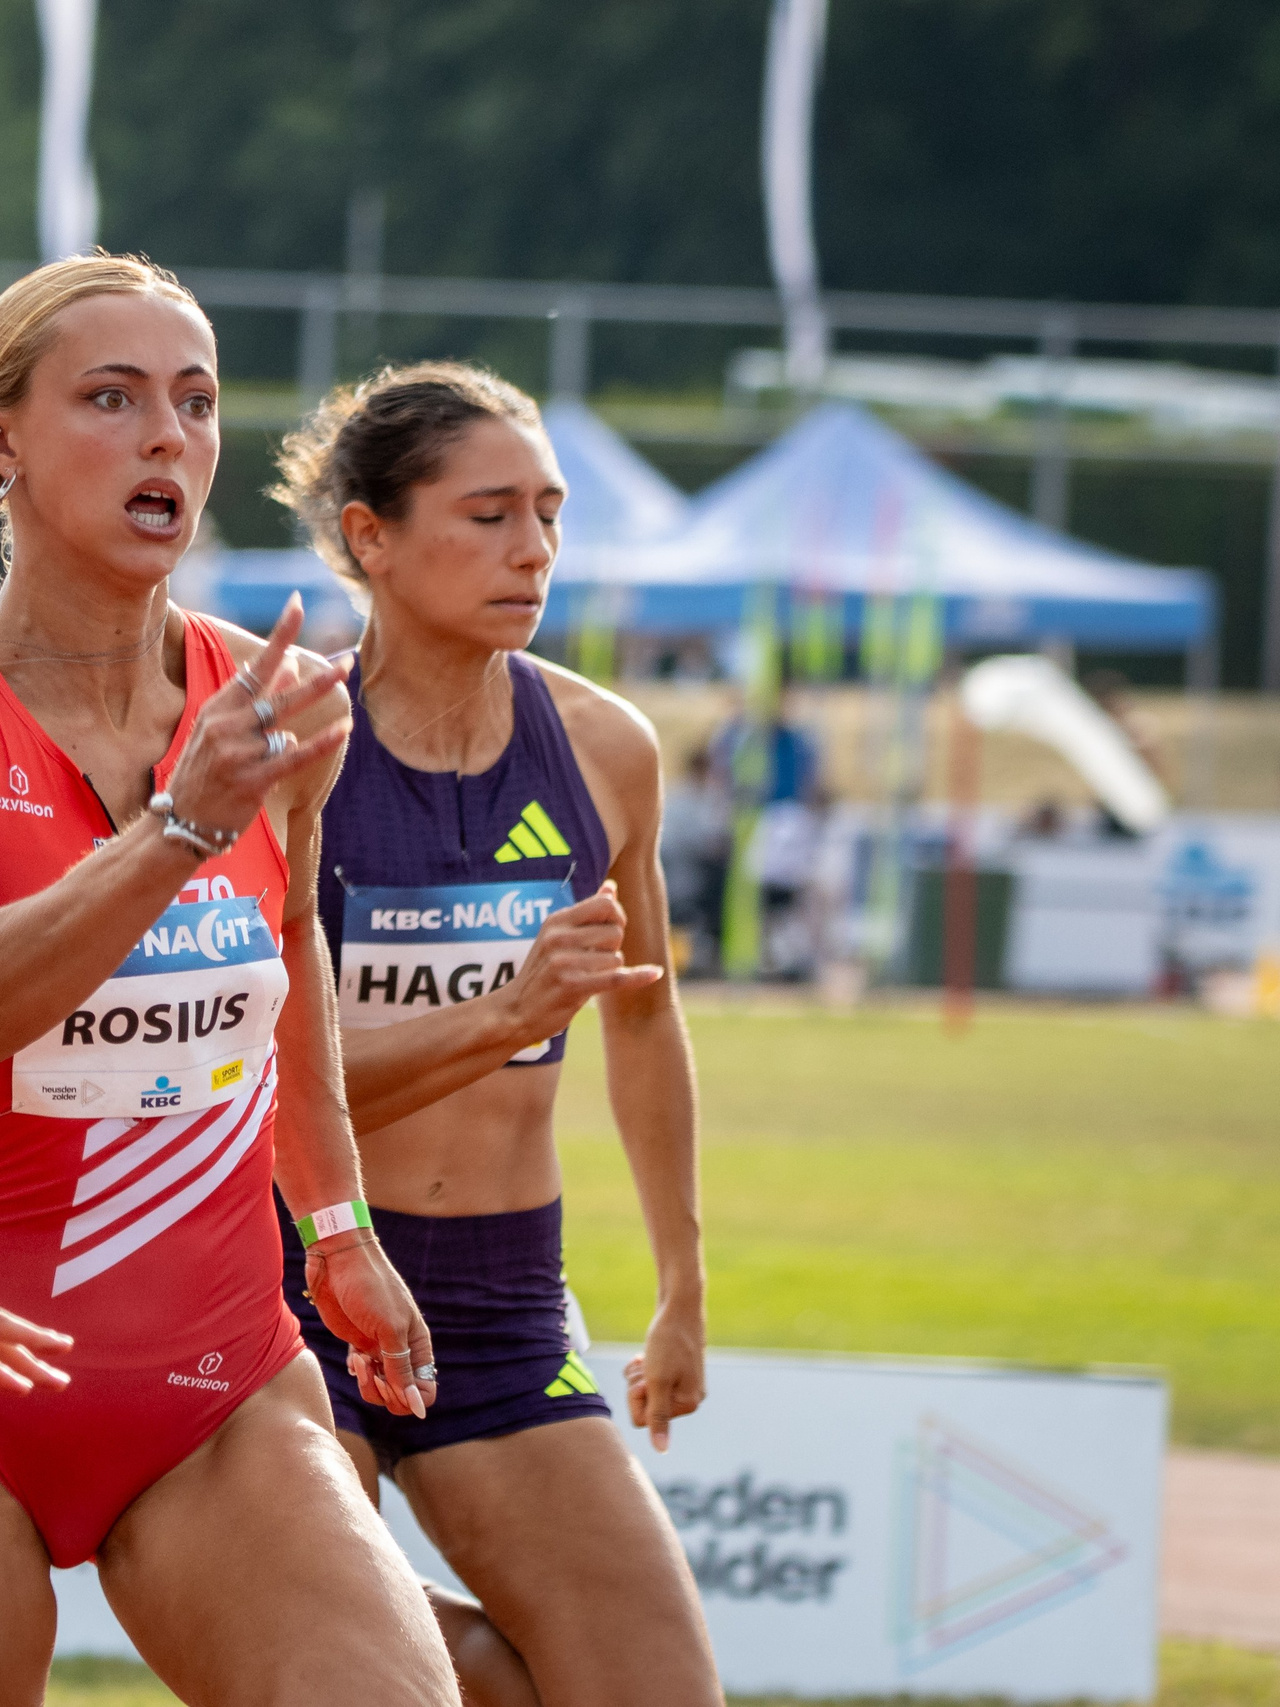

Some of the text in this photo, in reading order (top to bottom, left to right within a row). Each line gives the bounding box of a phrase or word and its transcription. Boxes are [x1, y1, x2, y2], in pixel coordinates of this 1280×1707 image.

[357, 961, 516, 1006] HAGA
[62, 993, 250, 1046] ROSIUS
[42, 1086, 77, 1094] heusden
[52, 1093, 77, 1101] zolder
[141, 1095, 182, 1109] KBC
[657, 1466, 846, 1536] sden
